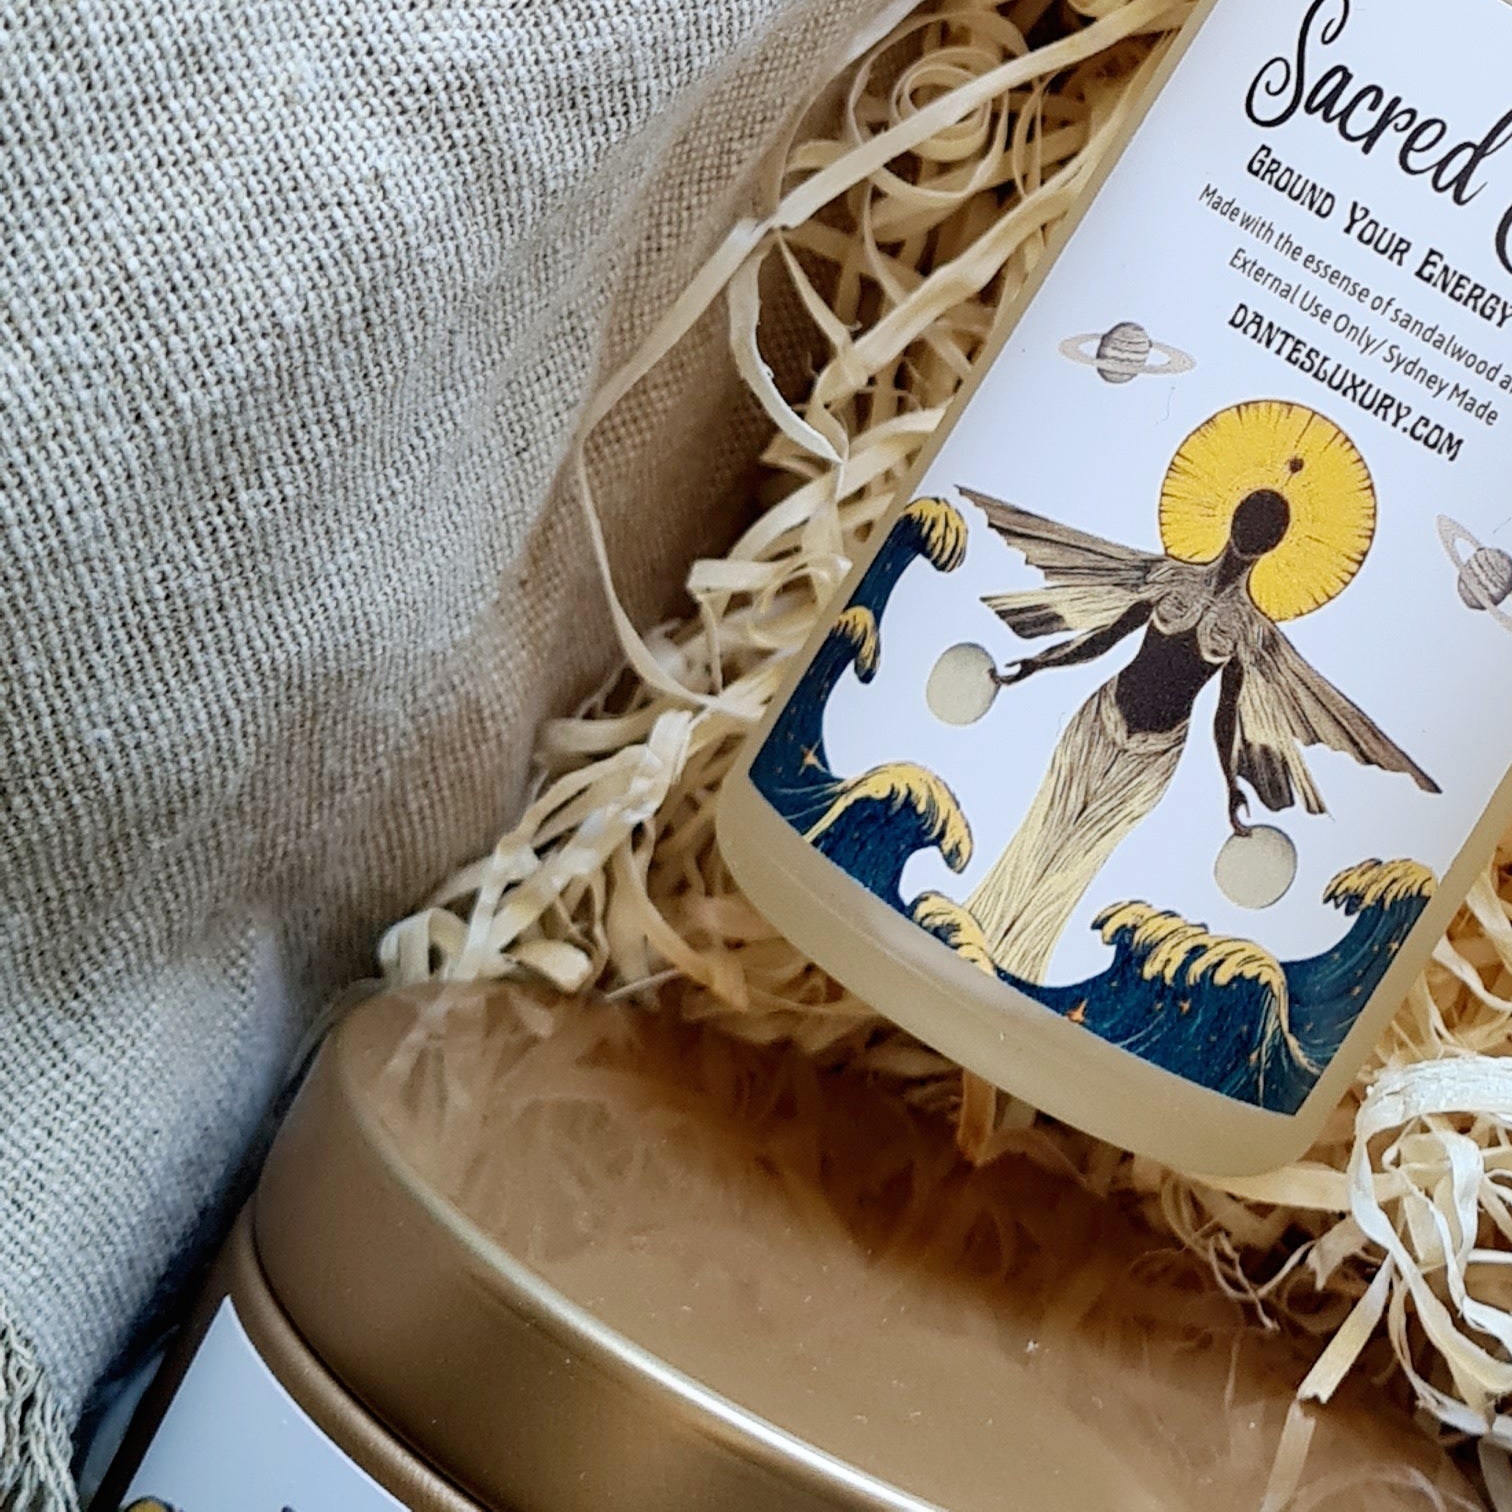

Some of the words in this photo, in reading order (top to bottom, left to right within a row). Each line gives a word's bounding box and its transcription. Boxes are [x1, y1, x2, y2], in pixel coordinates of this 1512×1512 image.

[1200, 184, 1239, 221] Made
[1240, 213, 1273, 243] with
[1275, 233, 1302, 261] the
[1303, 255, 1369, 302] essense
[1370, 296, 1396, 318] of
[1390, 309, 1502, 381] sandalwood
[1230, 248, 1301, 303] External
[1300, 291, 1331, 324] Use
[1383, 345, 1449, 397] Sydney
[1448, 384, 1497, 425] Made
[1228, 303, 1463, 461] DANTESLUXURY.COM
